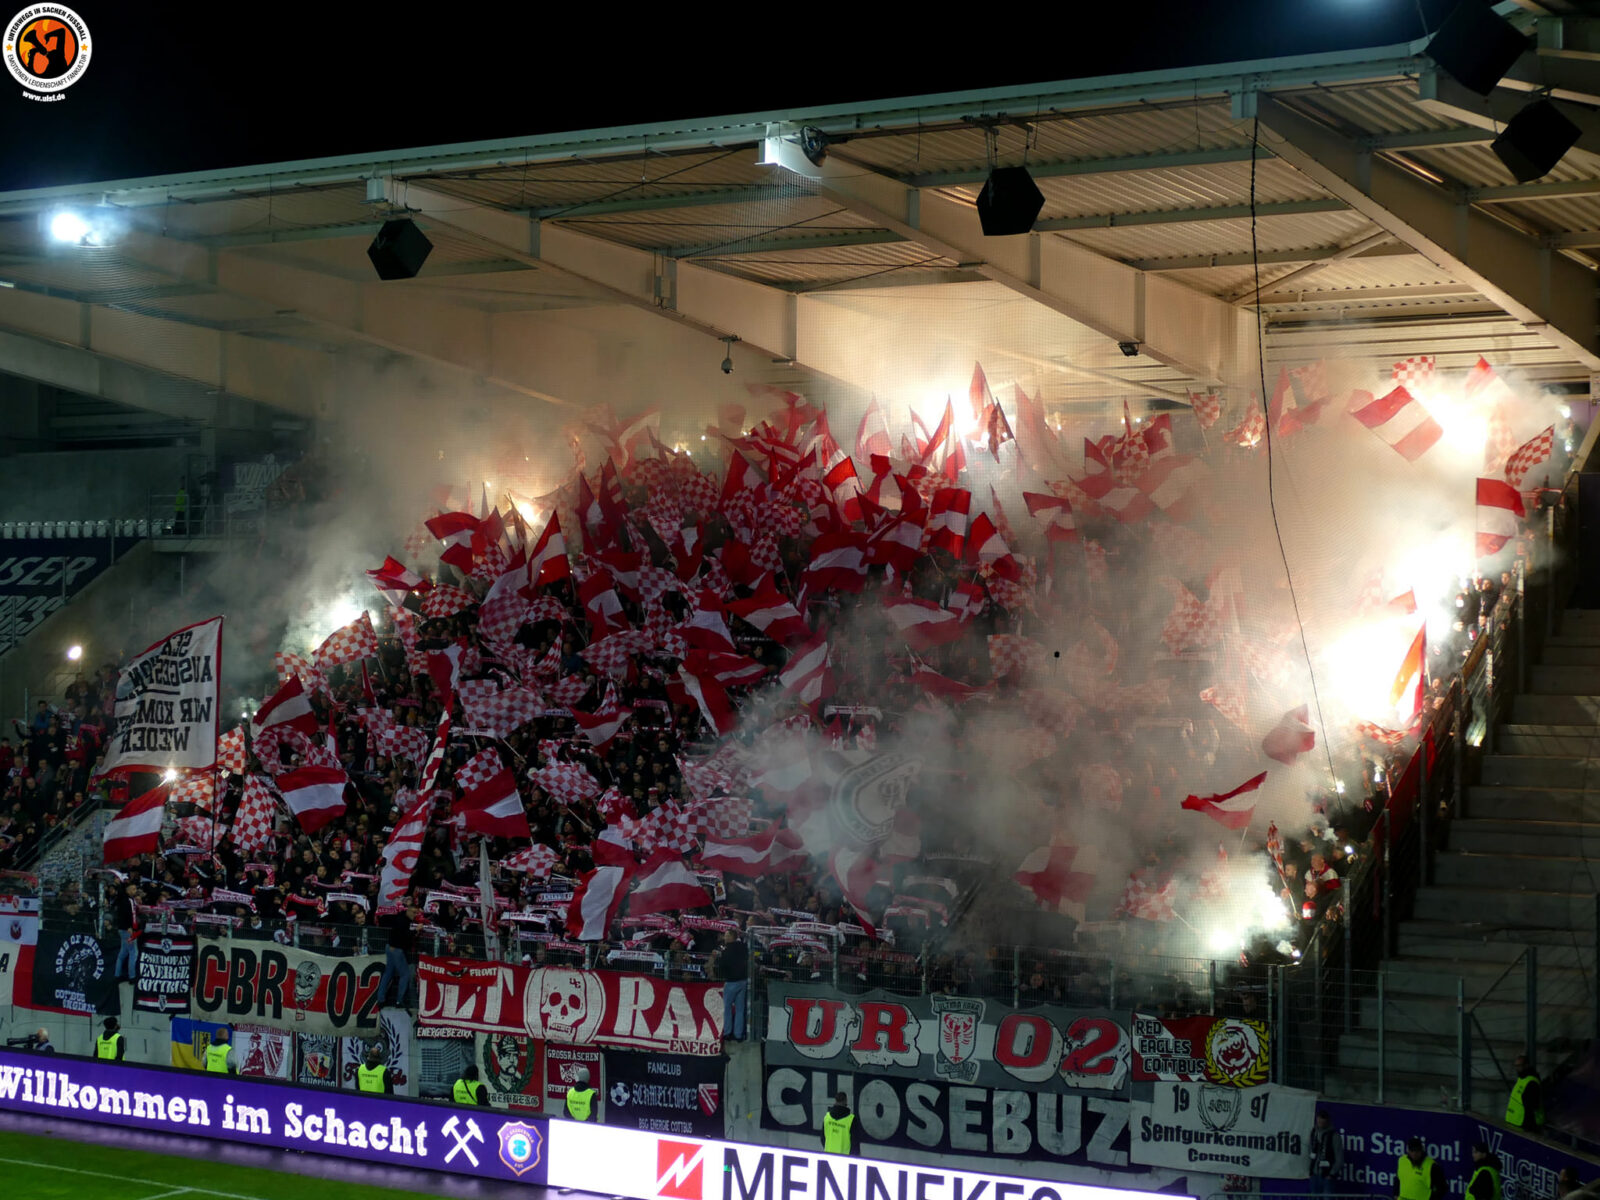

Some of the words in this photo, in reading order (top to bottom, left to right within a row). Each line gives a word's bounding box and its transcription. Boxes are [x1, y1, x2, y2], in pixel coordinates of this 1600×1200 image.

[418, 961, 445, 975] ELSTER
[469, 967, 498, 977] FRONT
[196, 945, 288, 1020] CBR
[326, 961, 387, 1029] 02
[1135, 1020, 1163, 1035] RED
[785, 997, 921, 1067] UR
[993, 1013, 1130, 1091] 02
[1140, 1038, 1192, 1054] EAGLES
[647, 1062, 682, 1076] FANCLUB
[1143, 1058, 1207, 1074] COTTBUS
[0, 1065, 211, 1127] Willkommen
[221, 1094, 272, 1135] im
[284, 1102, 428, 1157] Schacht
[766, 1067, 1131, 1167] CHOSEBUZ
[1172, 1084, 1190, 1114] 19
[1250, 1091, 1271, 1122] 97
[671, 1121, 693, 1134] COTTBUS
[1141, 1115, 1302, 1156] Senfgurkenmafia
[1188, 1148, 1251, 1167] Cottbus
[1370, 1132, 1461, 1162] Staion!
[723, 1147, 1063, 1200] MENN
